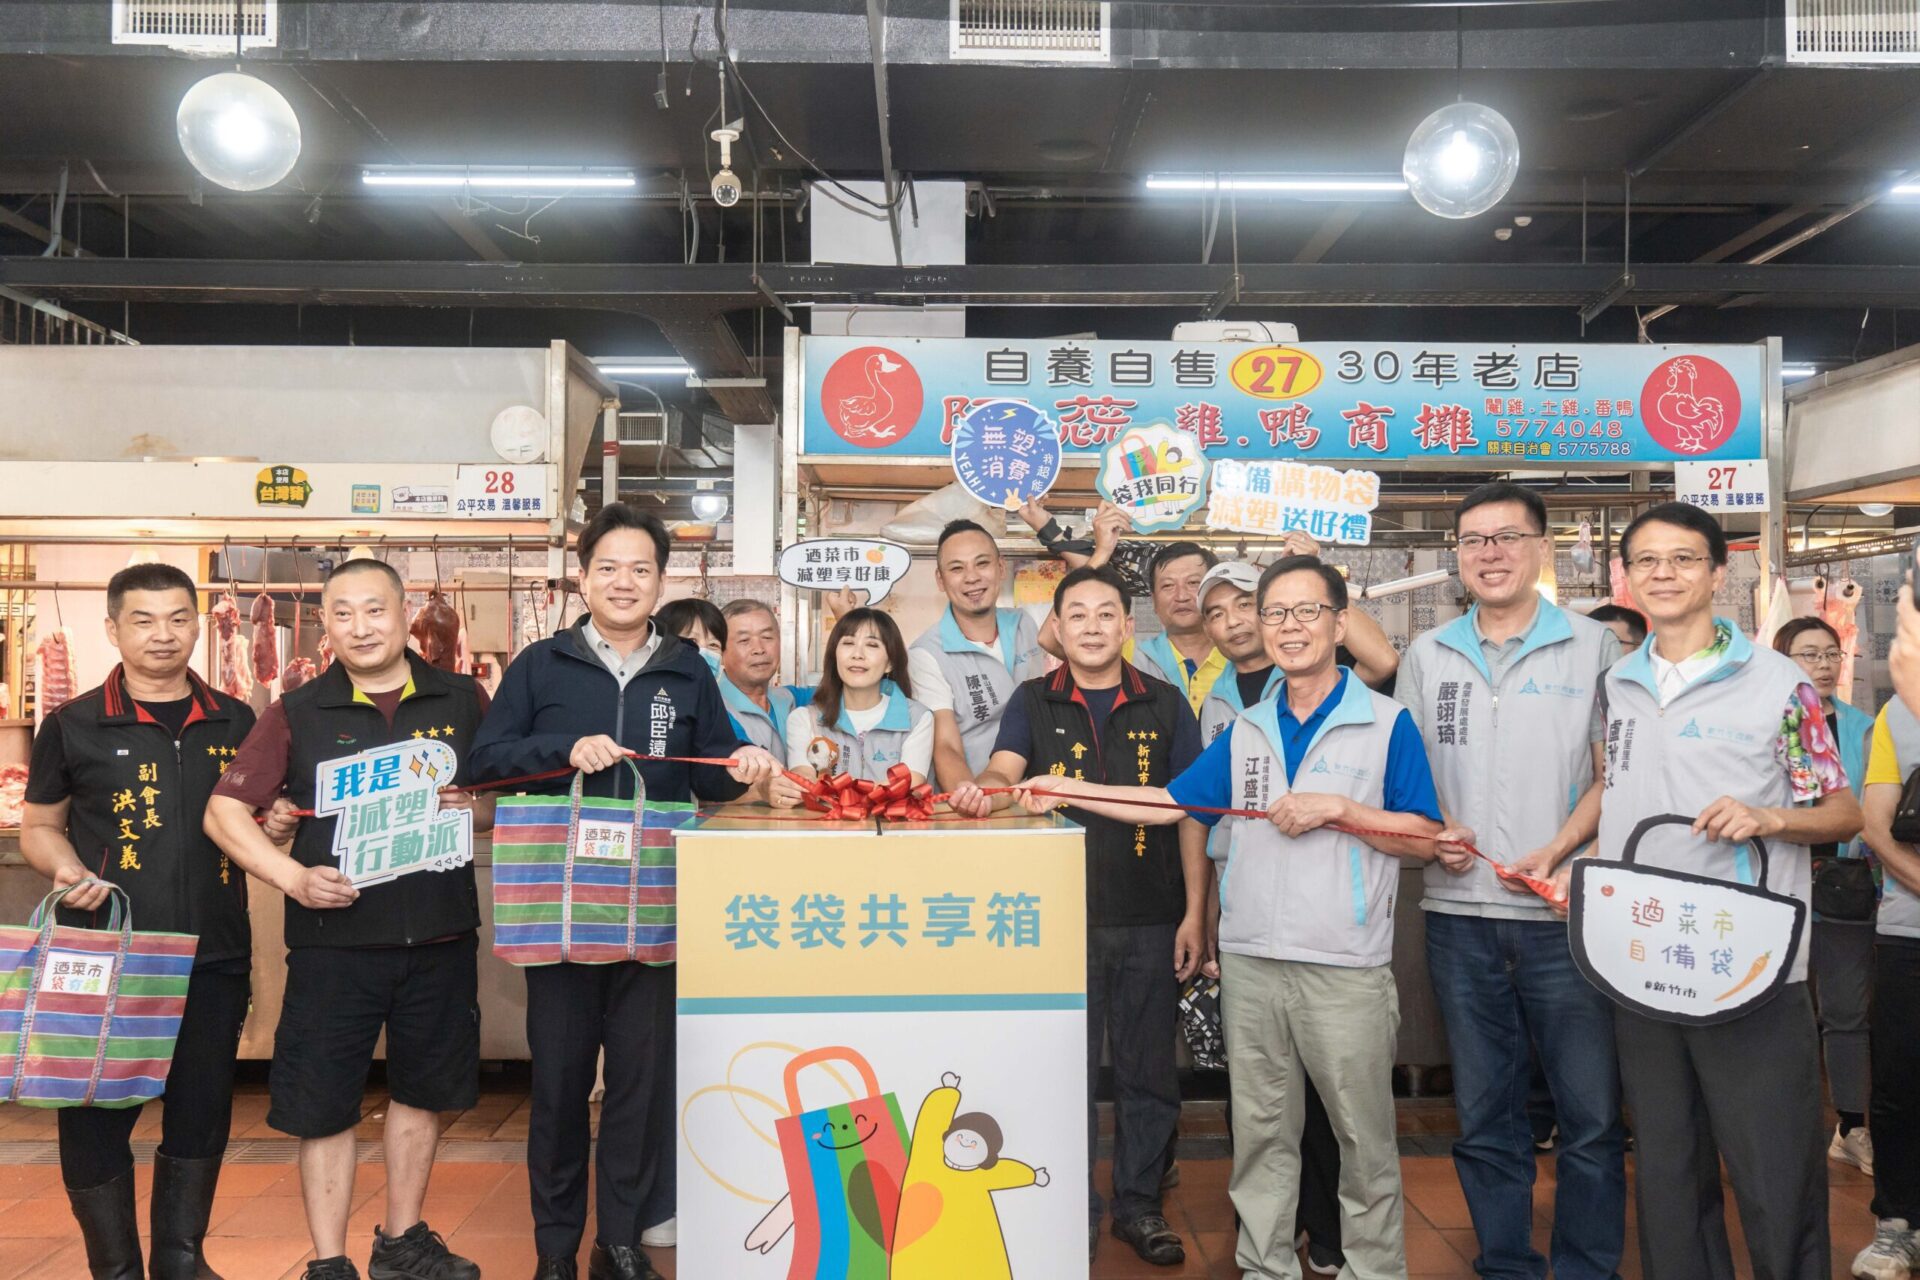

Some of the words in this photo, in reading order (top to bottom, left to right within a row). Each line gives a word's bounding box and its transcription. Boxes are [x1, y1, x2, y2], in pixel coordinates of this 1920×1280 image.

[985, 347, 1218, 385] 自養自售
[1249, 355, 1303, 394] 27
[1336, 349, 1583, 390] 30年老店
[980, 425, 1036, 458] 無塑
[1487, 441, 1552, 456] 關東自治會
[1558, 442, 1632, 456] 5775788
[1495, 419, 1623, 438] 5774048
[485, 470, 515, 494] 28
[957, 452, 986, 493] YEAH!
[981, 455, 1031, 481] 消費
[1031, 452, 1054, 493] 我超能
[1708, 467, 1738, 491] 27
[457, 498, 496, 511] 公平交易
[502, 497, 541, 511] 溫馨服務
[1112, 475, 1200, 506] 袋我同行
[797, 566, 891, 582] 減塑享好康
[648, 702, 669, 758] 邱臣遠
[138, 762, 163, 829] 副會長
[331, 754, 402, 802] 我是
[112, 788, 142, 870] 洪文義
[347, 788, 429, 840] 減塑
[354, 817, 461, 876] 行動派
[725, 892, 1041, 950] 袋袋共享箱
[1629, 939, 1734, 978] 自備袋
